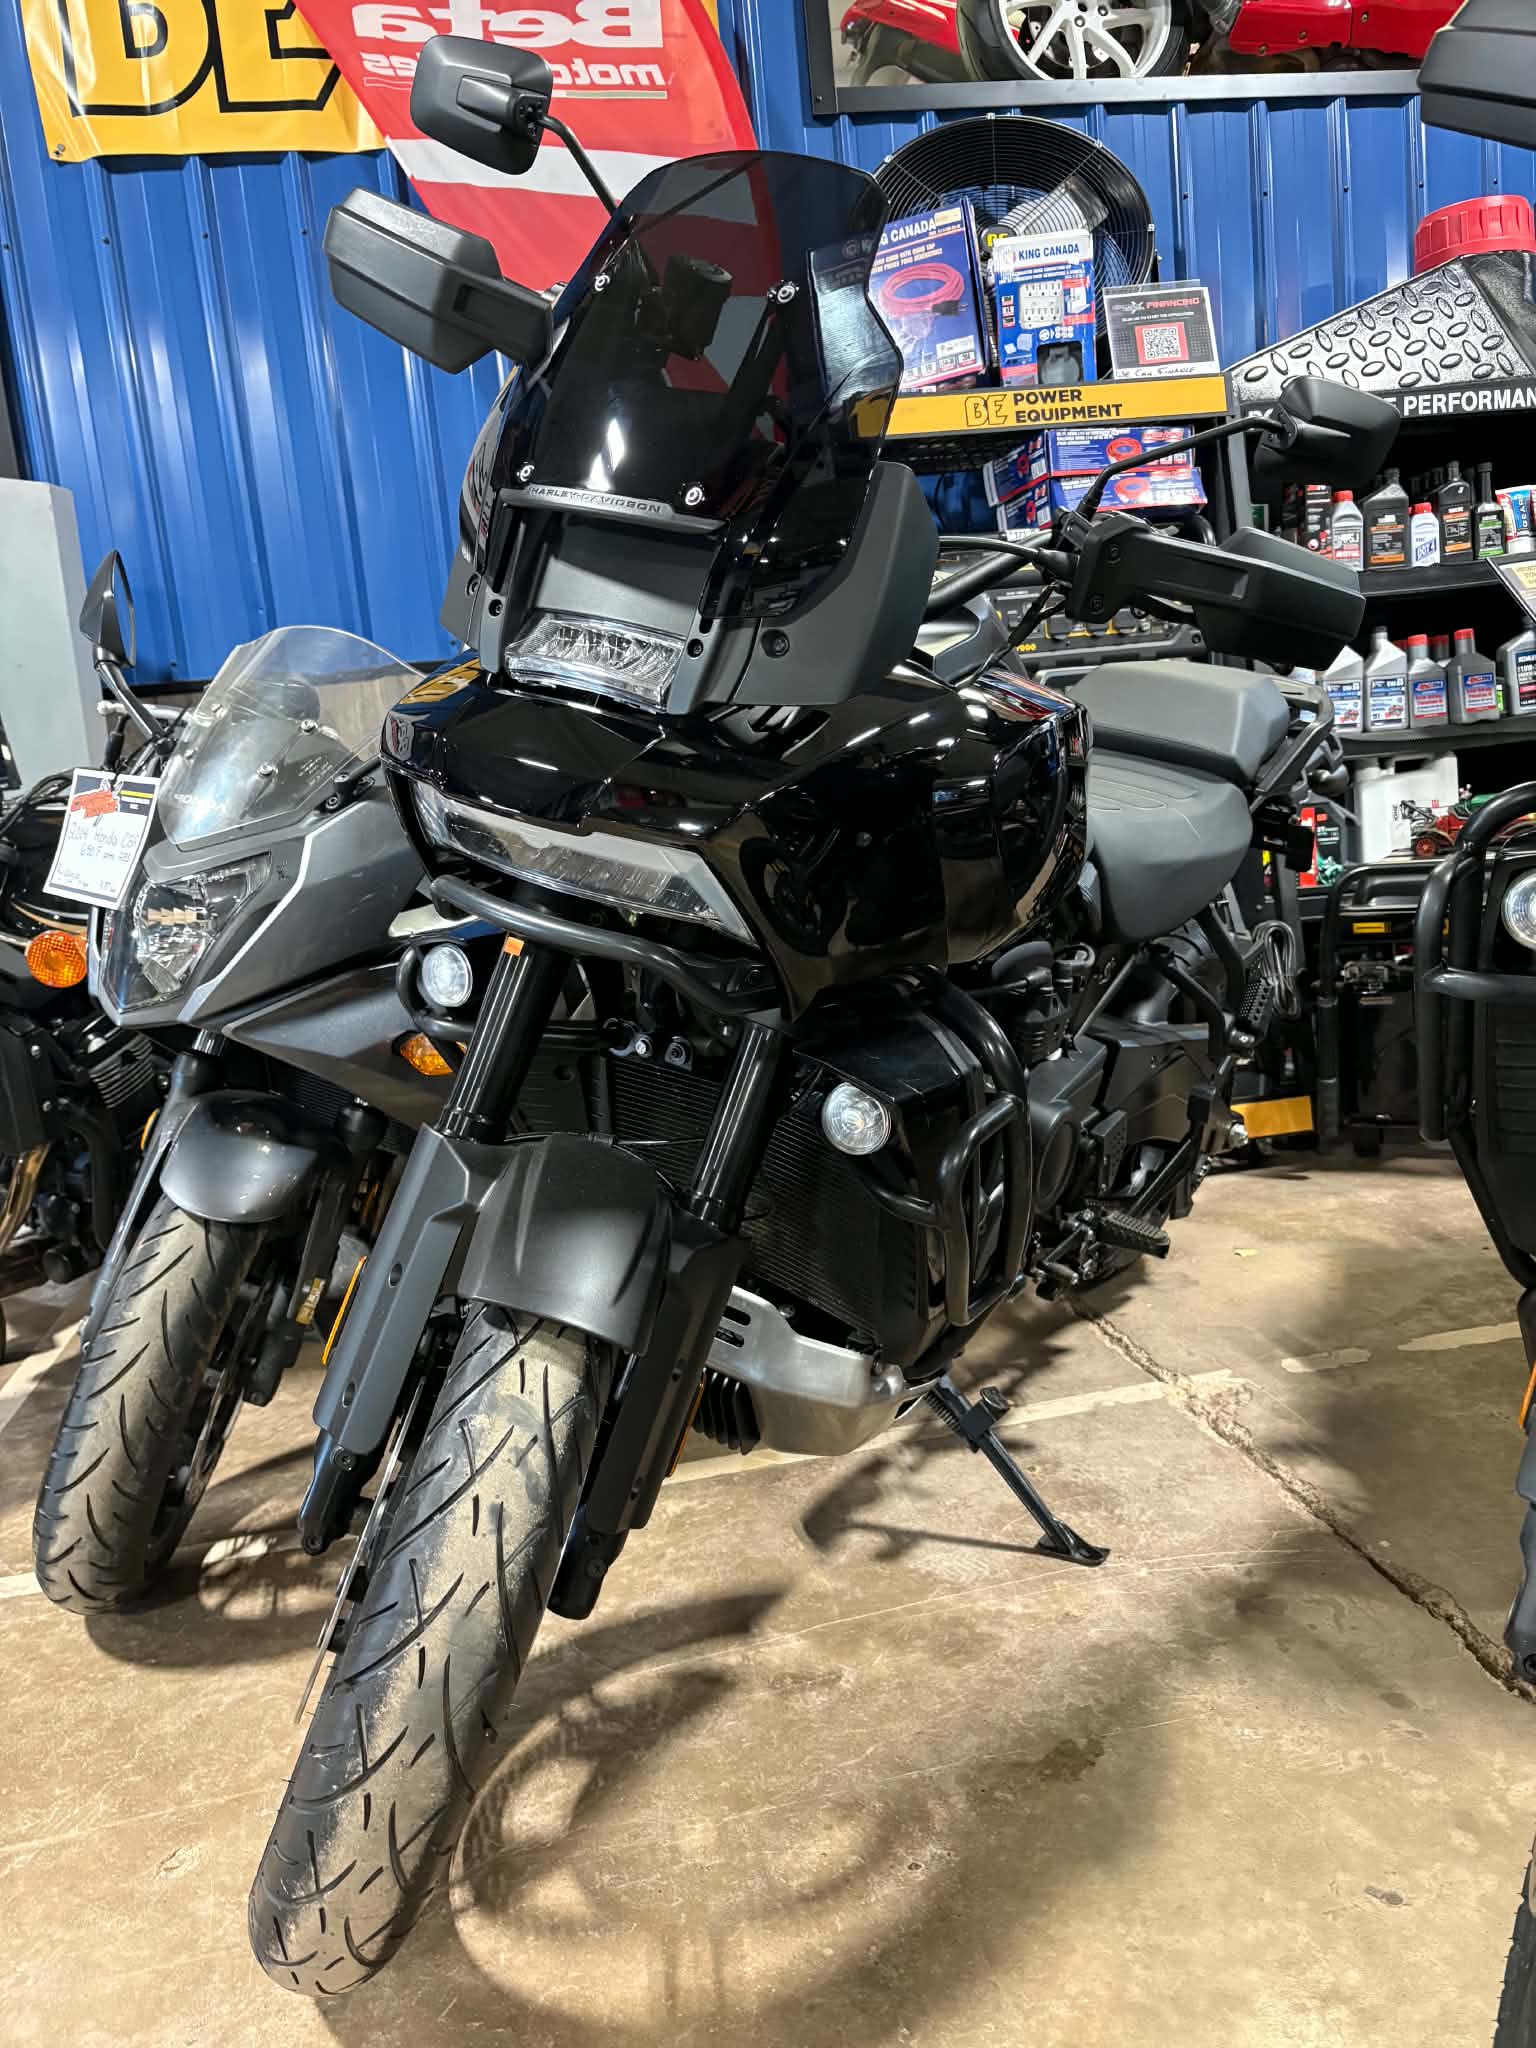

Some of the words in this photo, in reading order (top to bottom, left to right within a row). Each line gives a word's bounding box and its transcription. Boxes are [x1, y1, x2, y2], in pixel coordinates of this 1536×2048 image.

[890, 218, 937, 243] CANADA
[1018, 249, 1042, 260] KING
[1043, 243, 1080, 257] CANADA
[1013, 388, 1083, 406] POWER
[1403, 386, 1536, 417] PERFORMAN
[965, 394, 1009, 428] BE
[1015, 403, 1123, 424] EQUIPMENT
[530, 486, 662, 513] HARLEY-DAVIDSON
